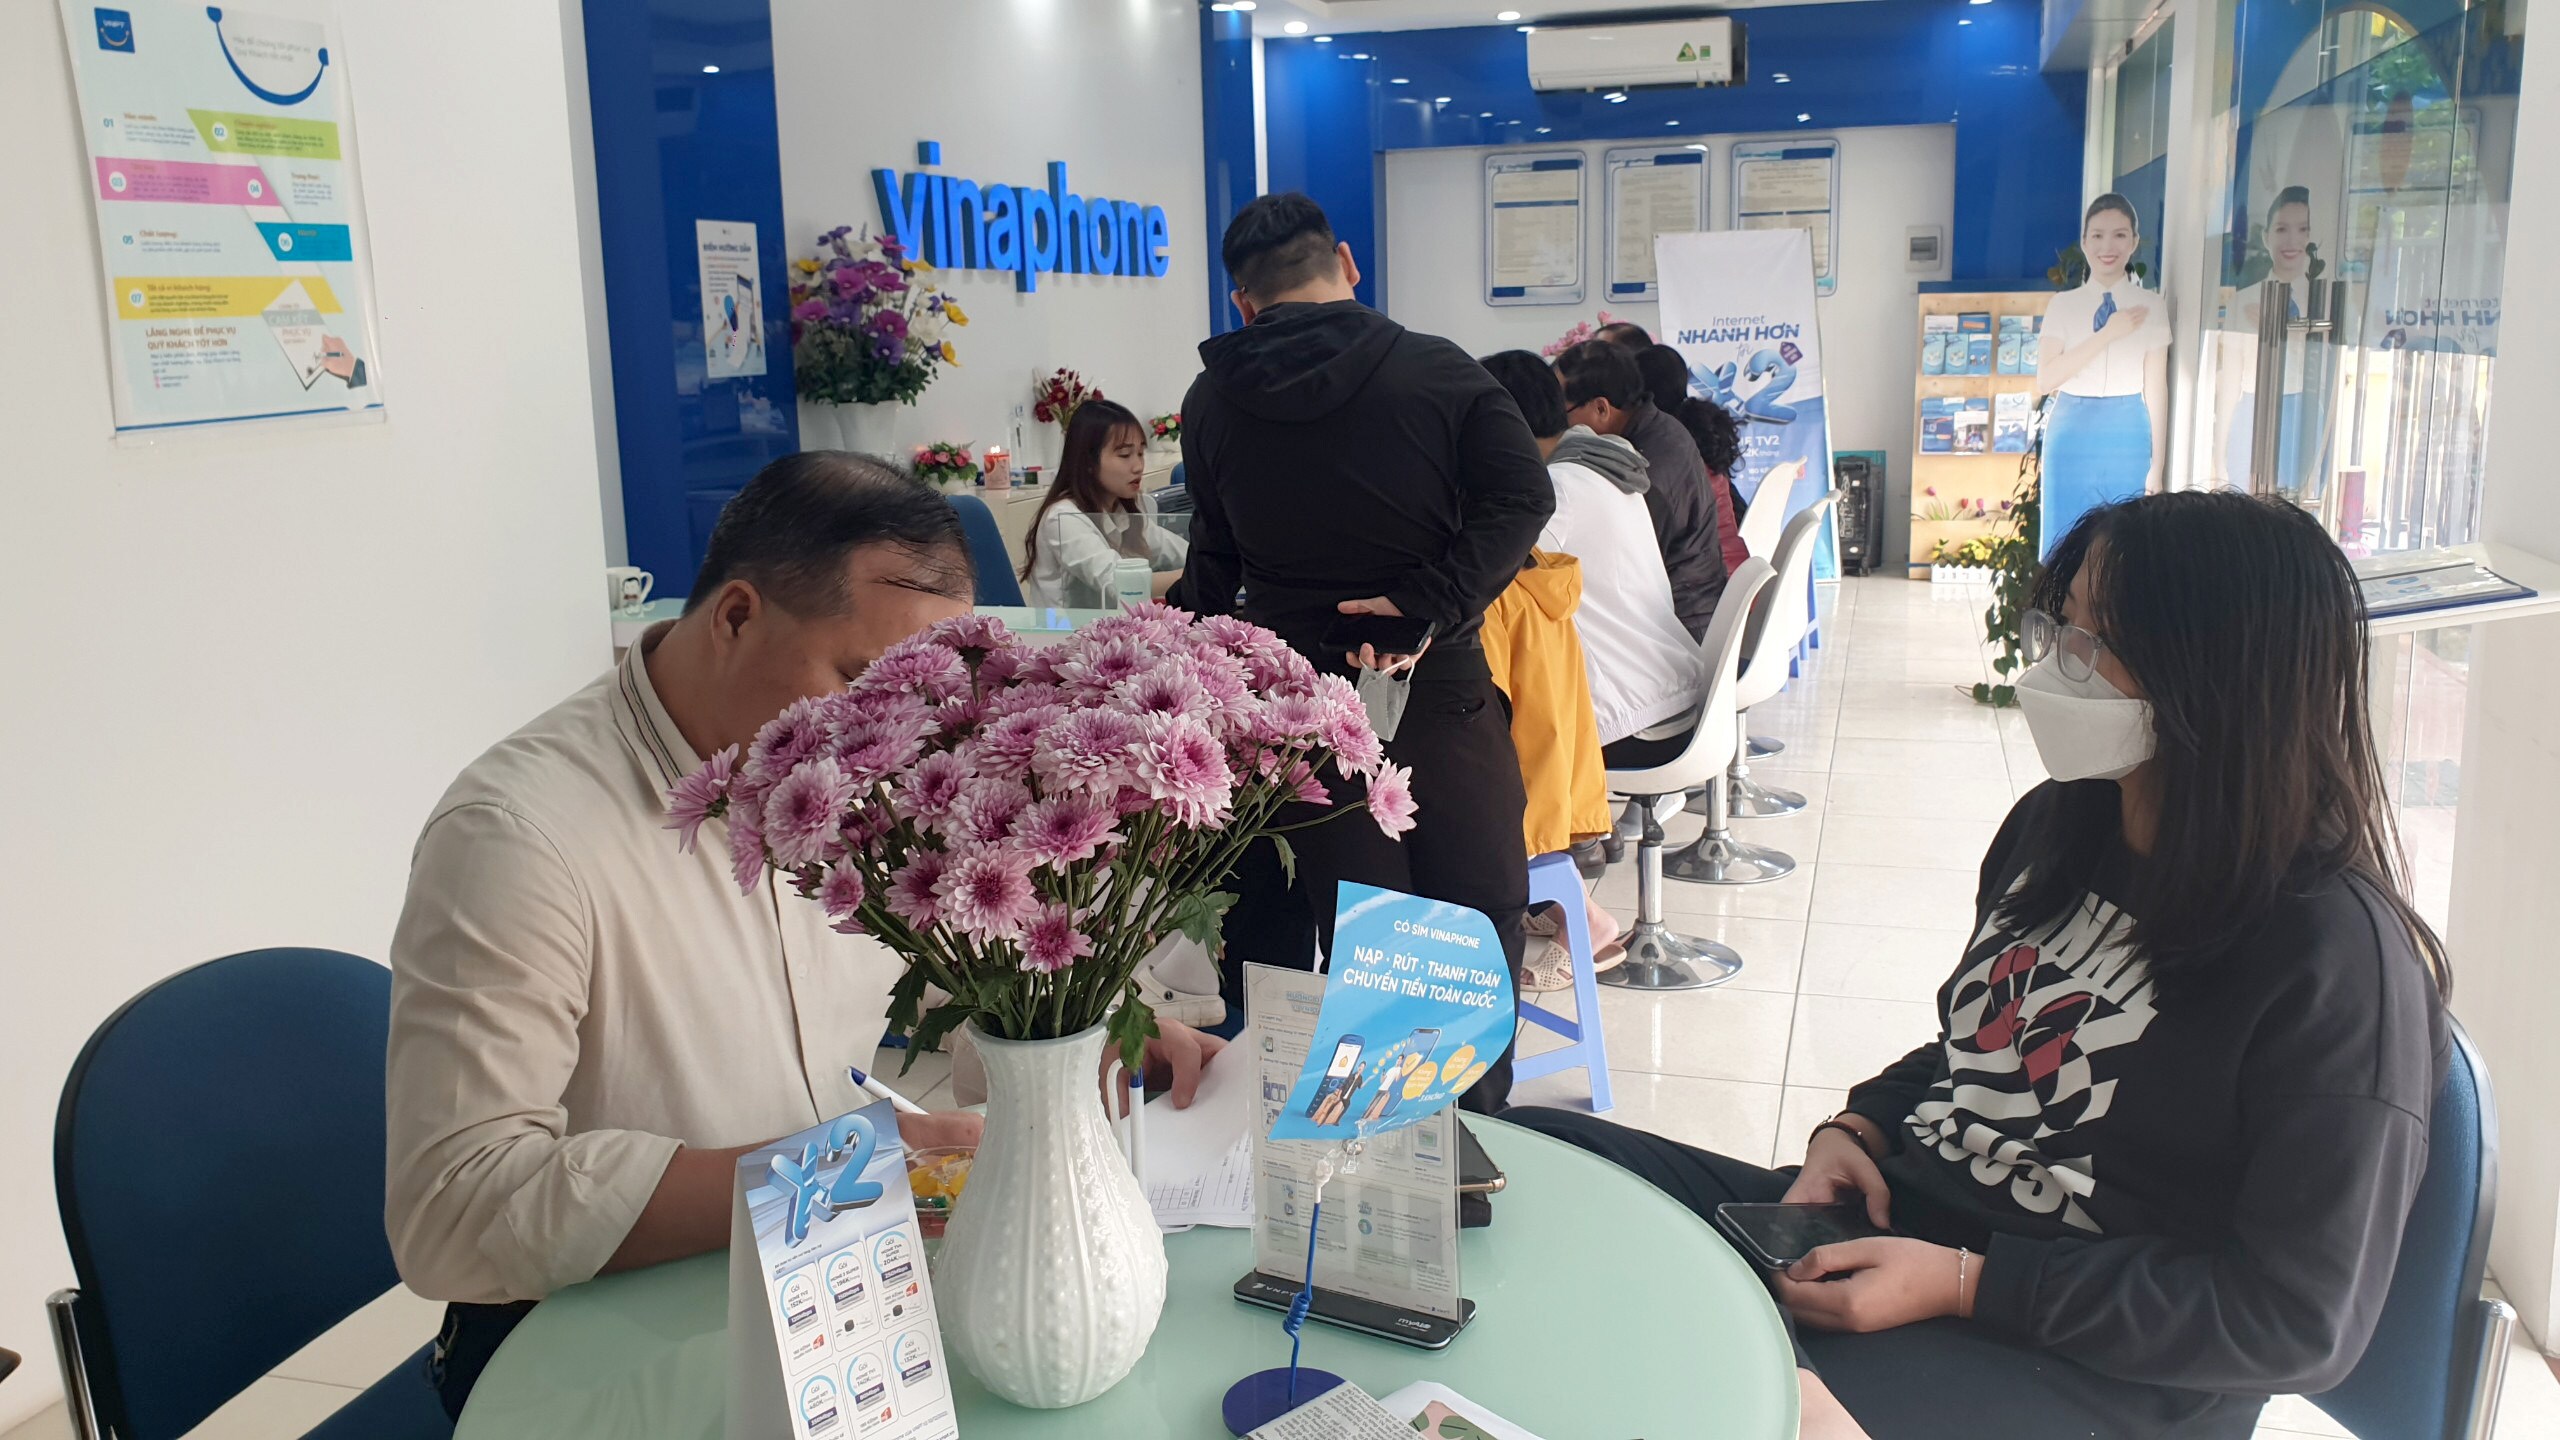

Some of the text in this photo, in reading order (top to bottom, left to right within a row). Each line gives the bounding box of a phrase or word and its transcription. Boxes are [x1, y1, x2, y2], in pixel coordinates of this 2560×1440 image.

[103, 118, 114, 128] 01
[214, 127, 225, 137] 02
[870, 140, 1169, 293] vinaphone
[131, 293, 142, 304] 07
[1712, 315, 1766, 326] Internet
[1678, 322, 1800, 344] NHANH HƠN
[1755, 434, 1780, 446] TV2
[1394, 919, 1480, 949] CÓ SIM VINAPHONE
[1353, 944, 1502, 988] NẠP RÚT THANH TOÁN
[1343, 968, 1497, 1009] CHUYỂN TIỀN TOÀN QUỐC
[766, 1114, 884, 1249] X2
[790, 1284, 800, 1293] Gói
[905, 1340, 914, 1348] Gói
[858, 1363, 868, 1372] Gói
[810, 1385, 820, 1394] Gói
